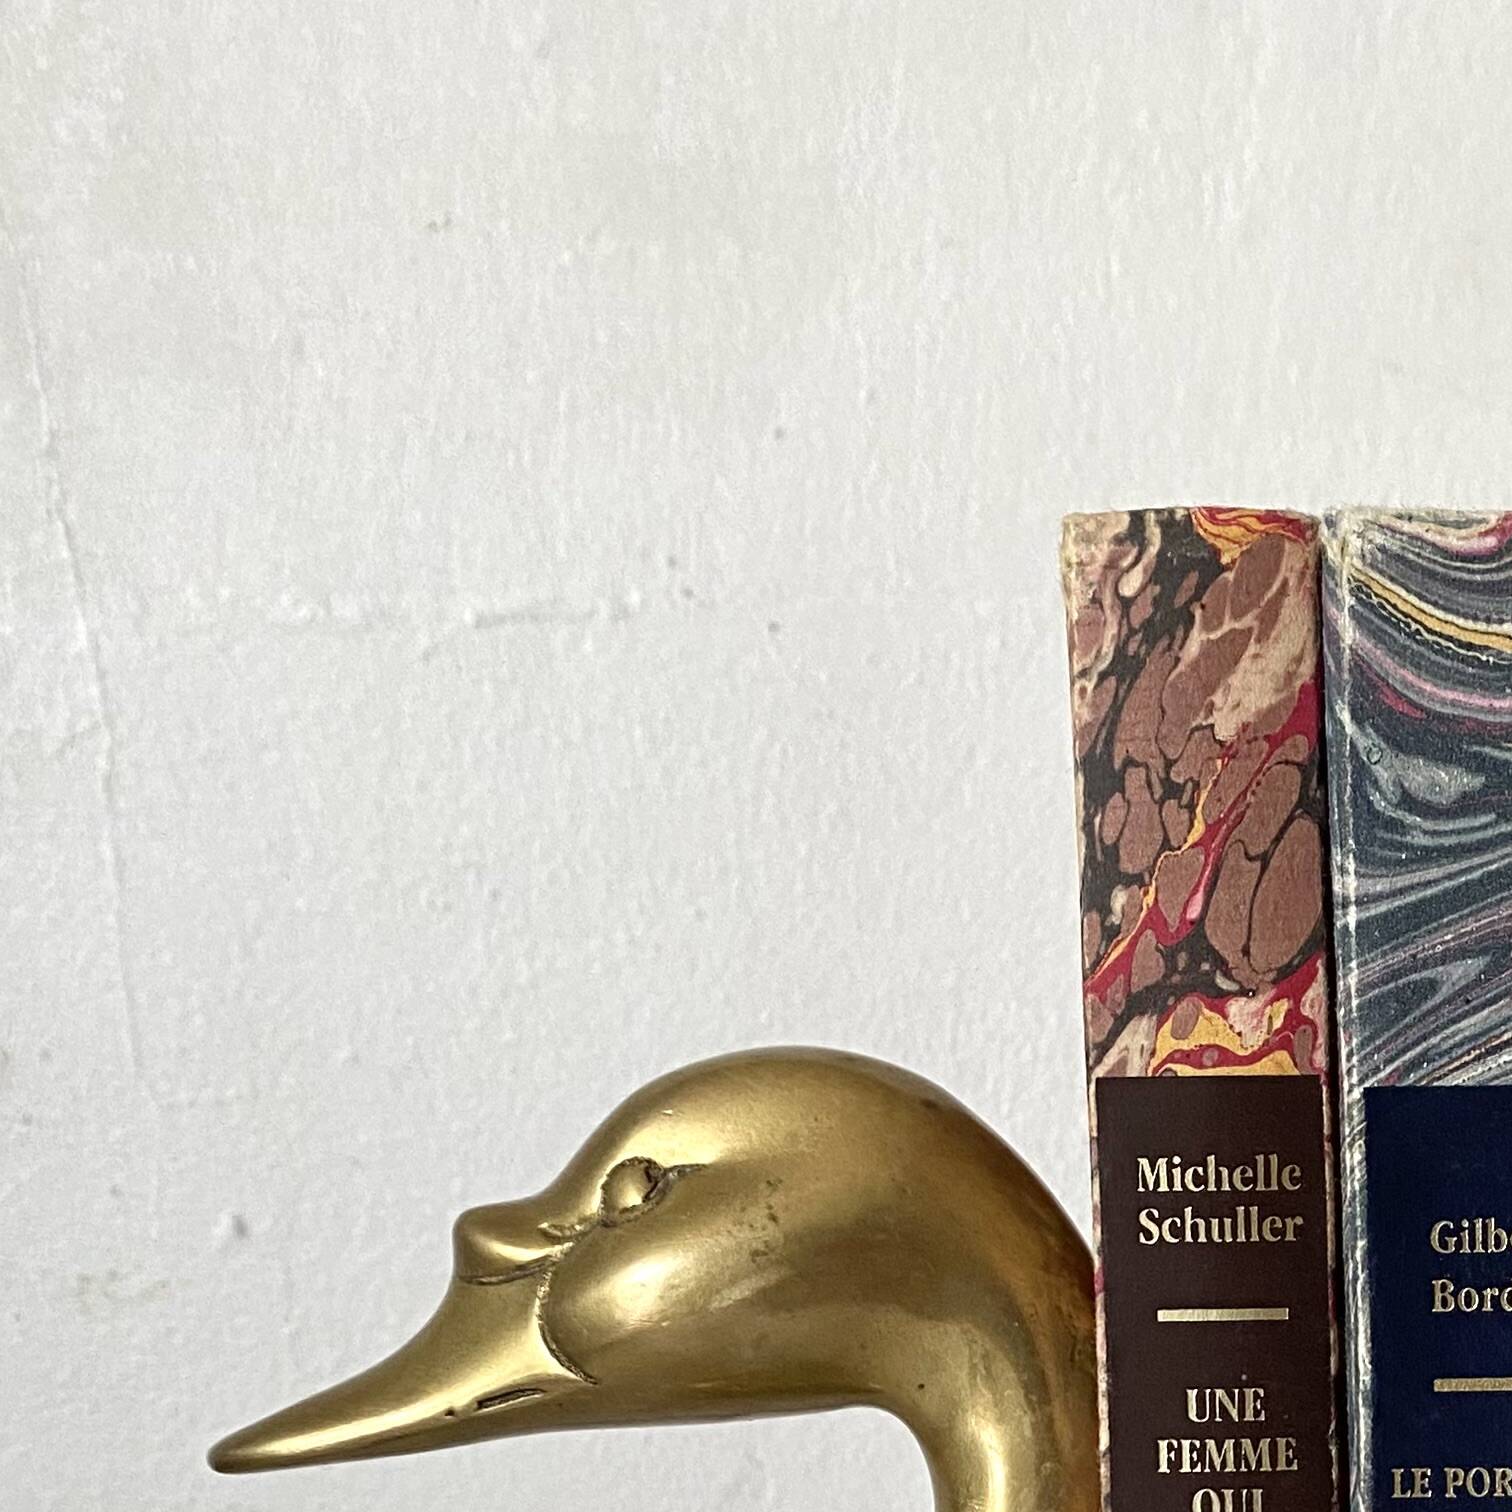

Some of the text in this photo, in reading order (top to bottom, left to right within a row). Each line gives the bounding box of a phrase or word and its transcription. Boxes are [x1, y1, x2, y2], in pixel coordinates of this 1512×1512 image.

[1136, 1154, 1302, 1193] Michelle
[1138, 1206, 1304, 1245] Schuller
[1187, 1387, 1266, 1423] UNE
[1156, 1437, 1298, 1474] FEMME
[1391, 1467, 1433, 1499] LE
